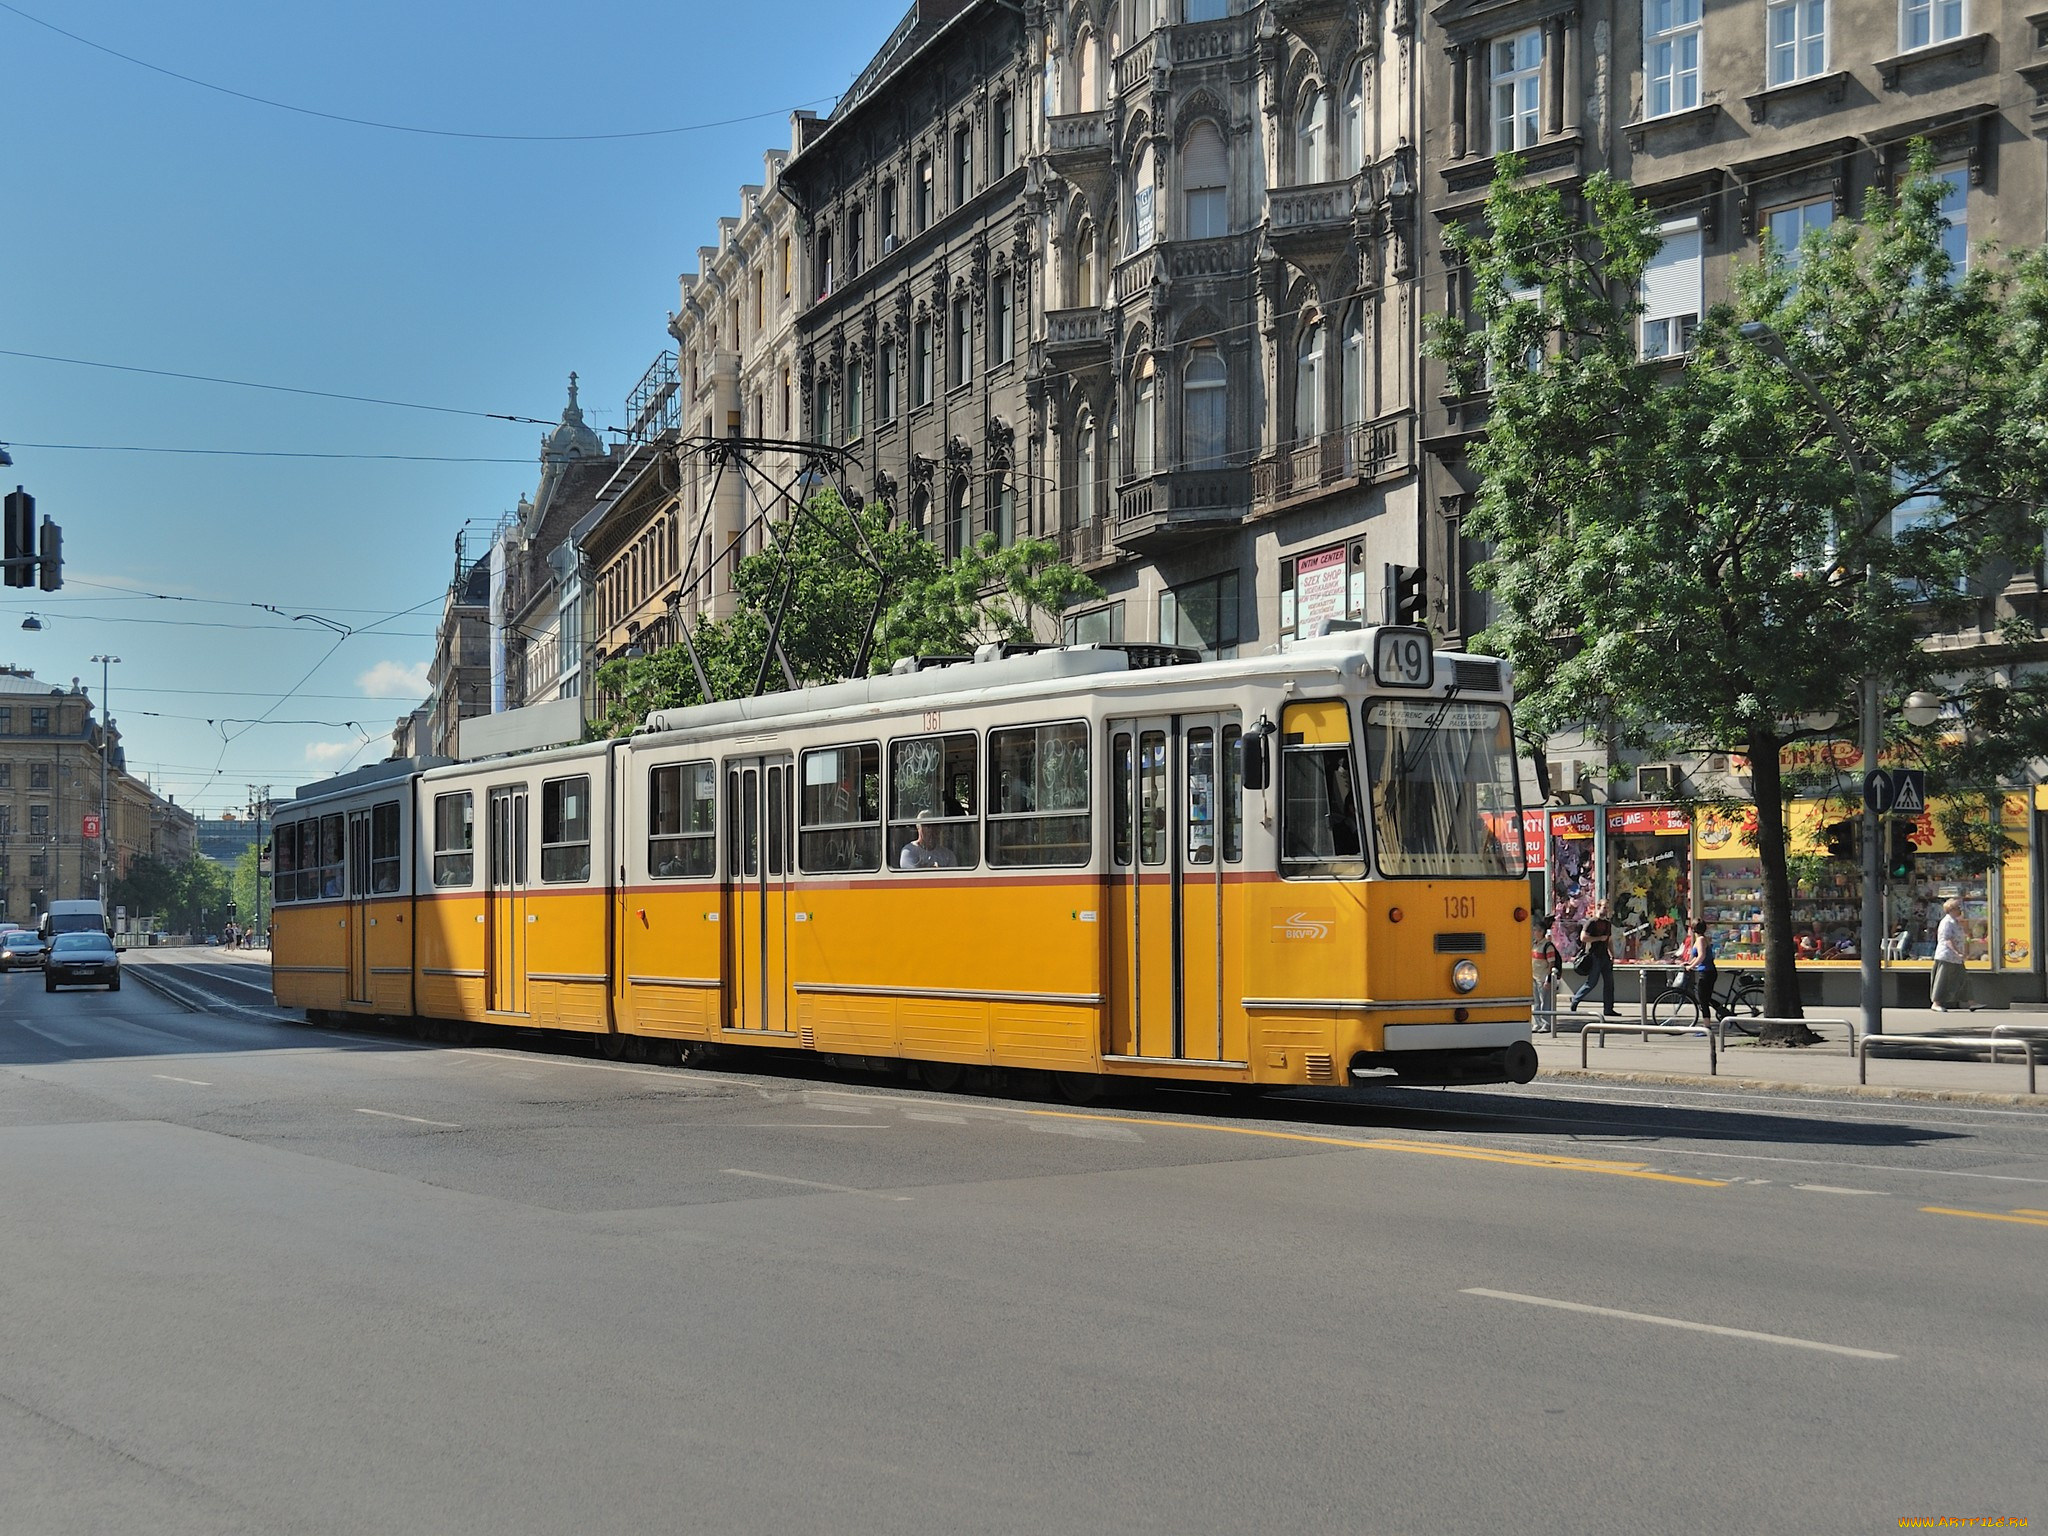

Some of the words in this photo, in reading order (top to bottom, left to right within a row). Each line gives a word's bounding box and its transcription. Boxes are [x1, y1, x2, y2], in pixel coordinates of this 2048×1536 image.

[1301, 558, 1319, 570] INTIM
[1321, 550, 1345, 564] CENTER
[1304, 574, 1321, 588] SZEX
[1323, 569, 1342, 582] SHOP
[1386, 639, 1422, 681] 49
[923, 711, 941, 731] 1361
[1552, 813, 1587, 828] KELME:
[1609, 812, 1645, 828] KELME:
[1444, 896, 1475, 919] 1361
